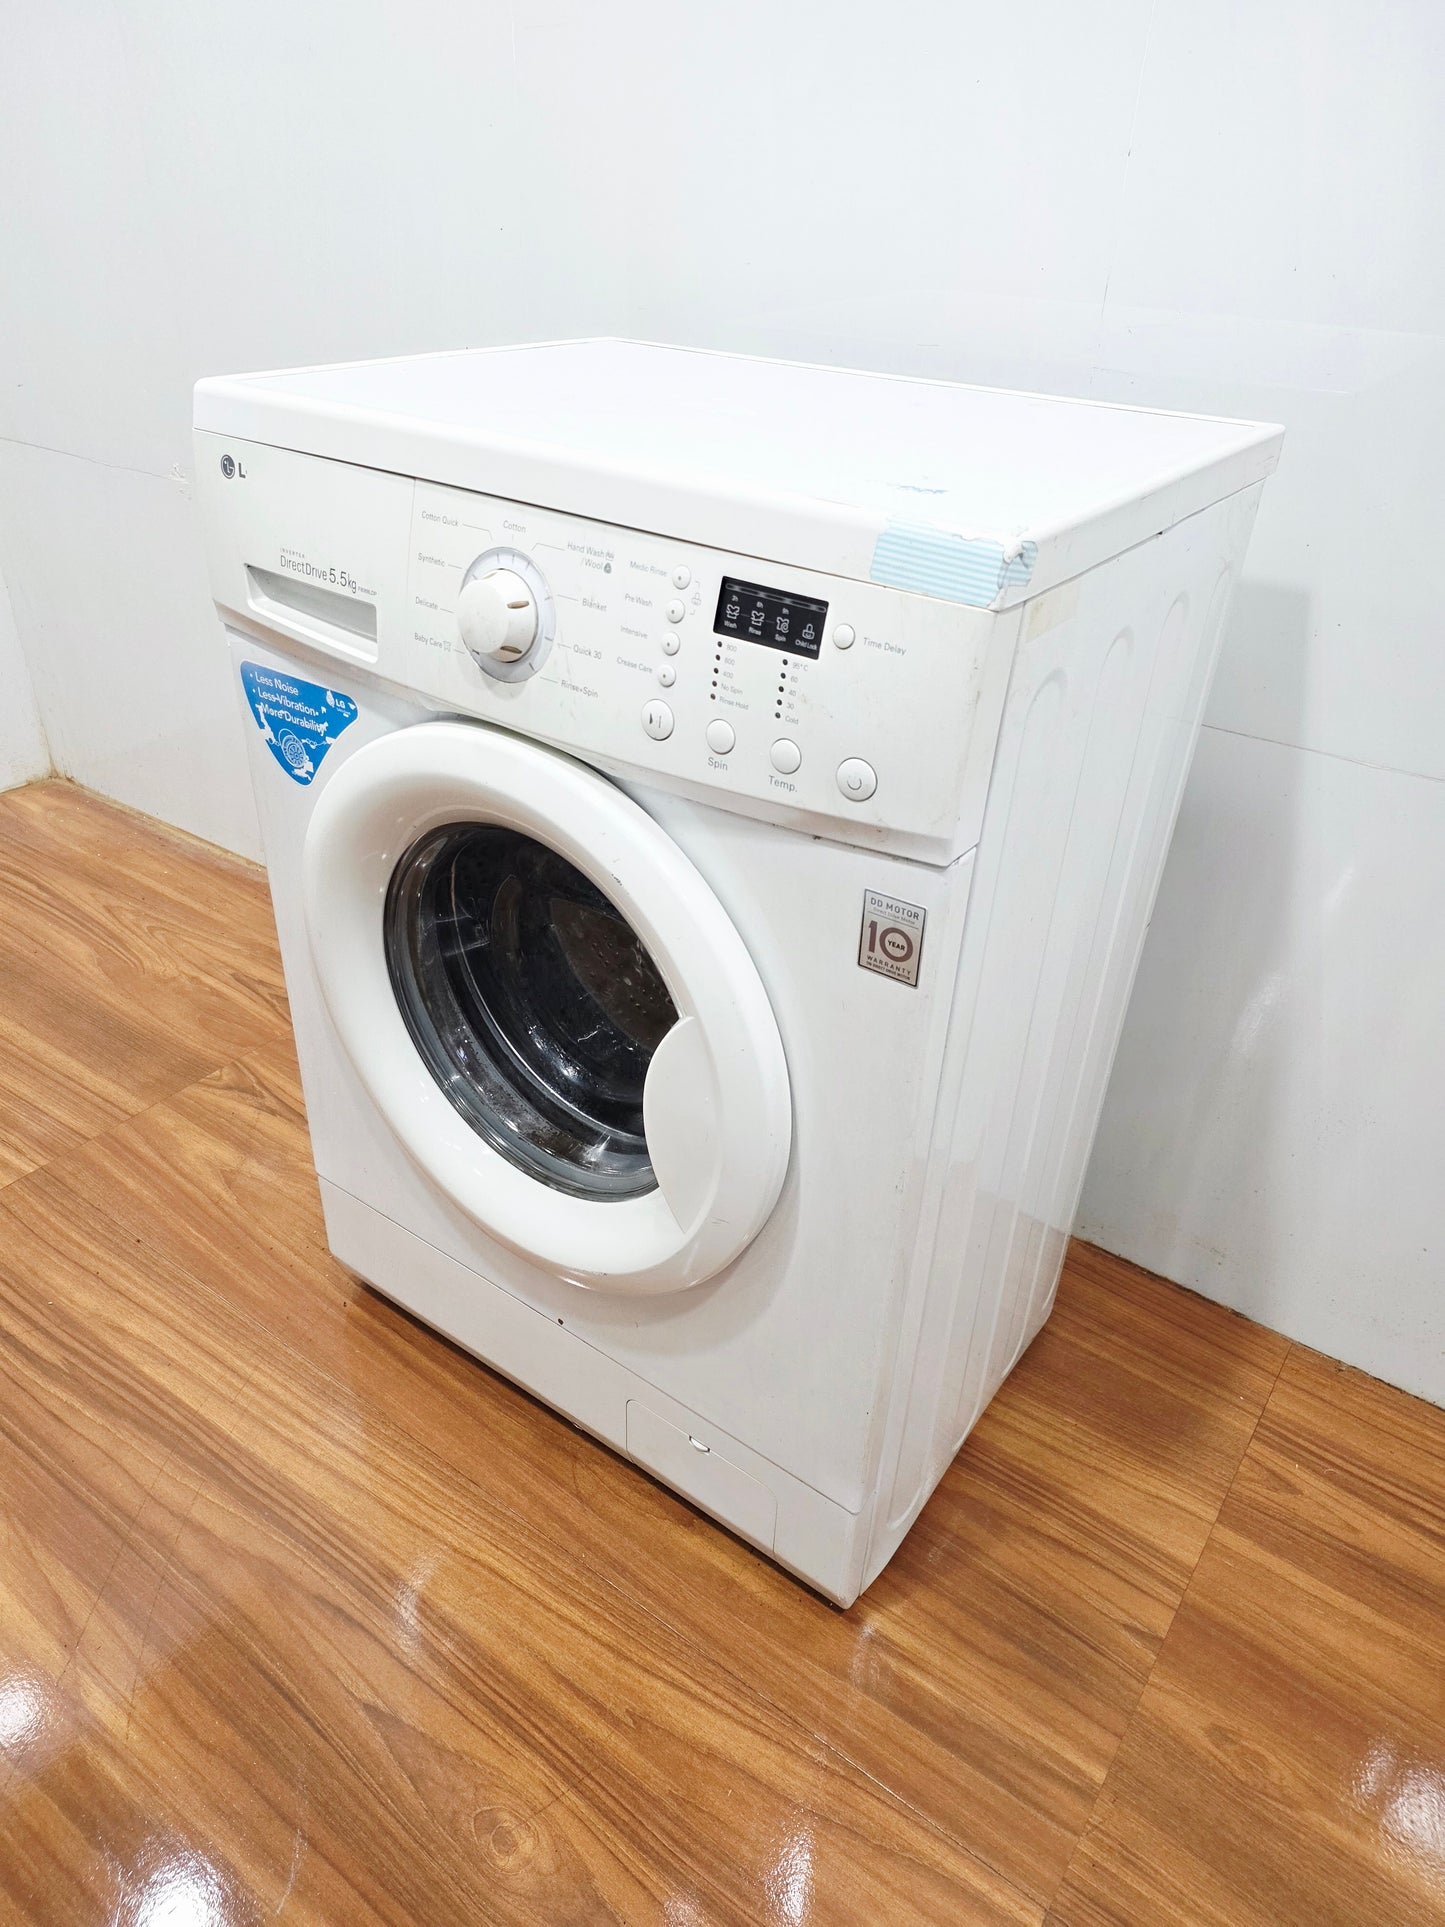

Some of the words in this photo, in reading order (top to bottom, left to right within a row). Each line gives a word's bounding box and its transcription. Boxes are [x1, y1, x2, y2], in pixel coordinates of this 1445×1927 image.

[421, 510, 440, 522] Cotton
[442, 515, 459, 526] Quick
[503, 520, 527, 534] Cotton
[567, 542, 585, 553] Hand
[586, 546, 605, 558] Wash
[415, 595, 439, 610] Delicate
[582, 597, 608, 612] Blanket
[636, 596, 653, 607] Wash
[414, 632, 429, 645] Baby
[429, 637, 443, 648] Care
[863, 636, 882, 650] Time
[883, 642, 907, 656] Delay
[573, 643, 592, 657] Quick
[593, 651, 602, 660] 30
[638, 663, 654, 674] Care
[255, 671, 274, 687] Less
[274, 678, 299, 696] Noise
[561, 679, 599, 699] Rinse+Spin
[721, 683, 730, 692] No
[784, 715, 799, 725] Cold
[707, 757, 728, 771] Spin
[768, 775, 798, 793] Temp.
[870, 897, 883, 908] DD
[885, 902, 920, 921] MOTOR
[868, 920, 914, 962] 10
[887, 939, 906, 952] YEAR
[866, 954, 911, 976] WARRANTY
